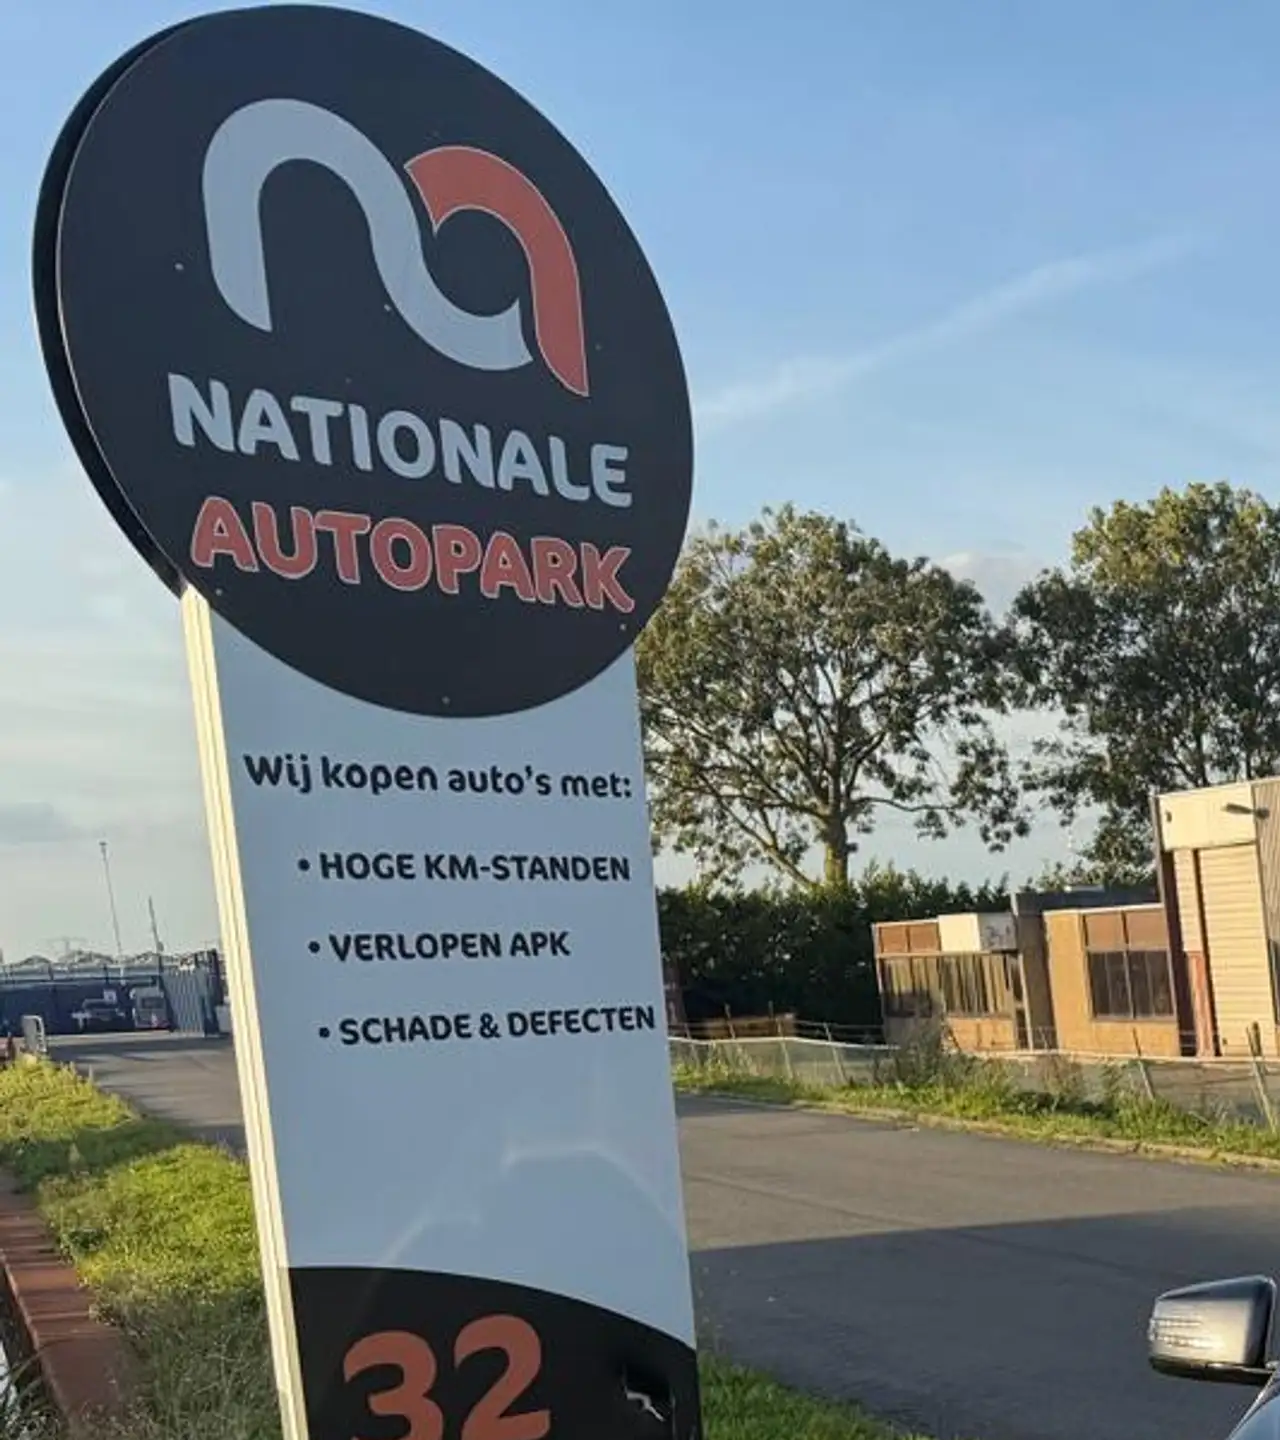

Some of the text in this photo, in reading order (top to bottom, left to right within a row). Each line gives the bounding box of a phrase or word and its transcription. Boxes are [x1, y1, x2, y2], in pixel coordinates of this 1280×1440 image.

[168, 372, 634, 508] NATIONALE
[191, 496, 635, 614] AUTOPARK
[244, 754, 633, 799] Wij kopen auto's met:
[320, 852, 631, 883] HOGE KM-STANDEN
[329, 931, 572, 963] VERLOPEN APK
[340, 1006, 656, 1047] SCHADE & DEFECTEN
